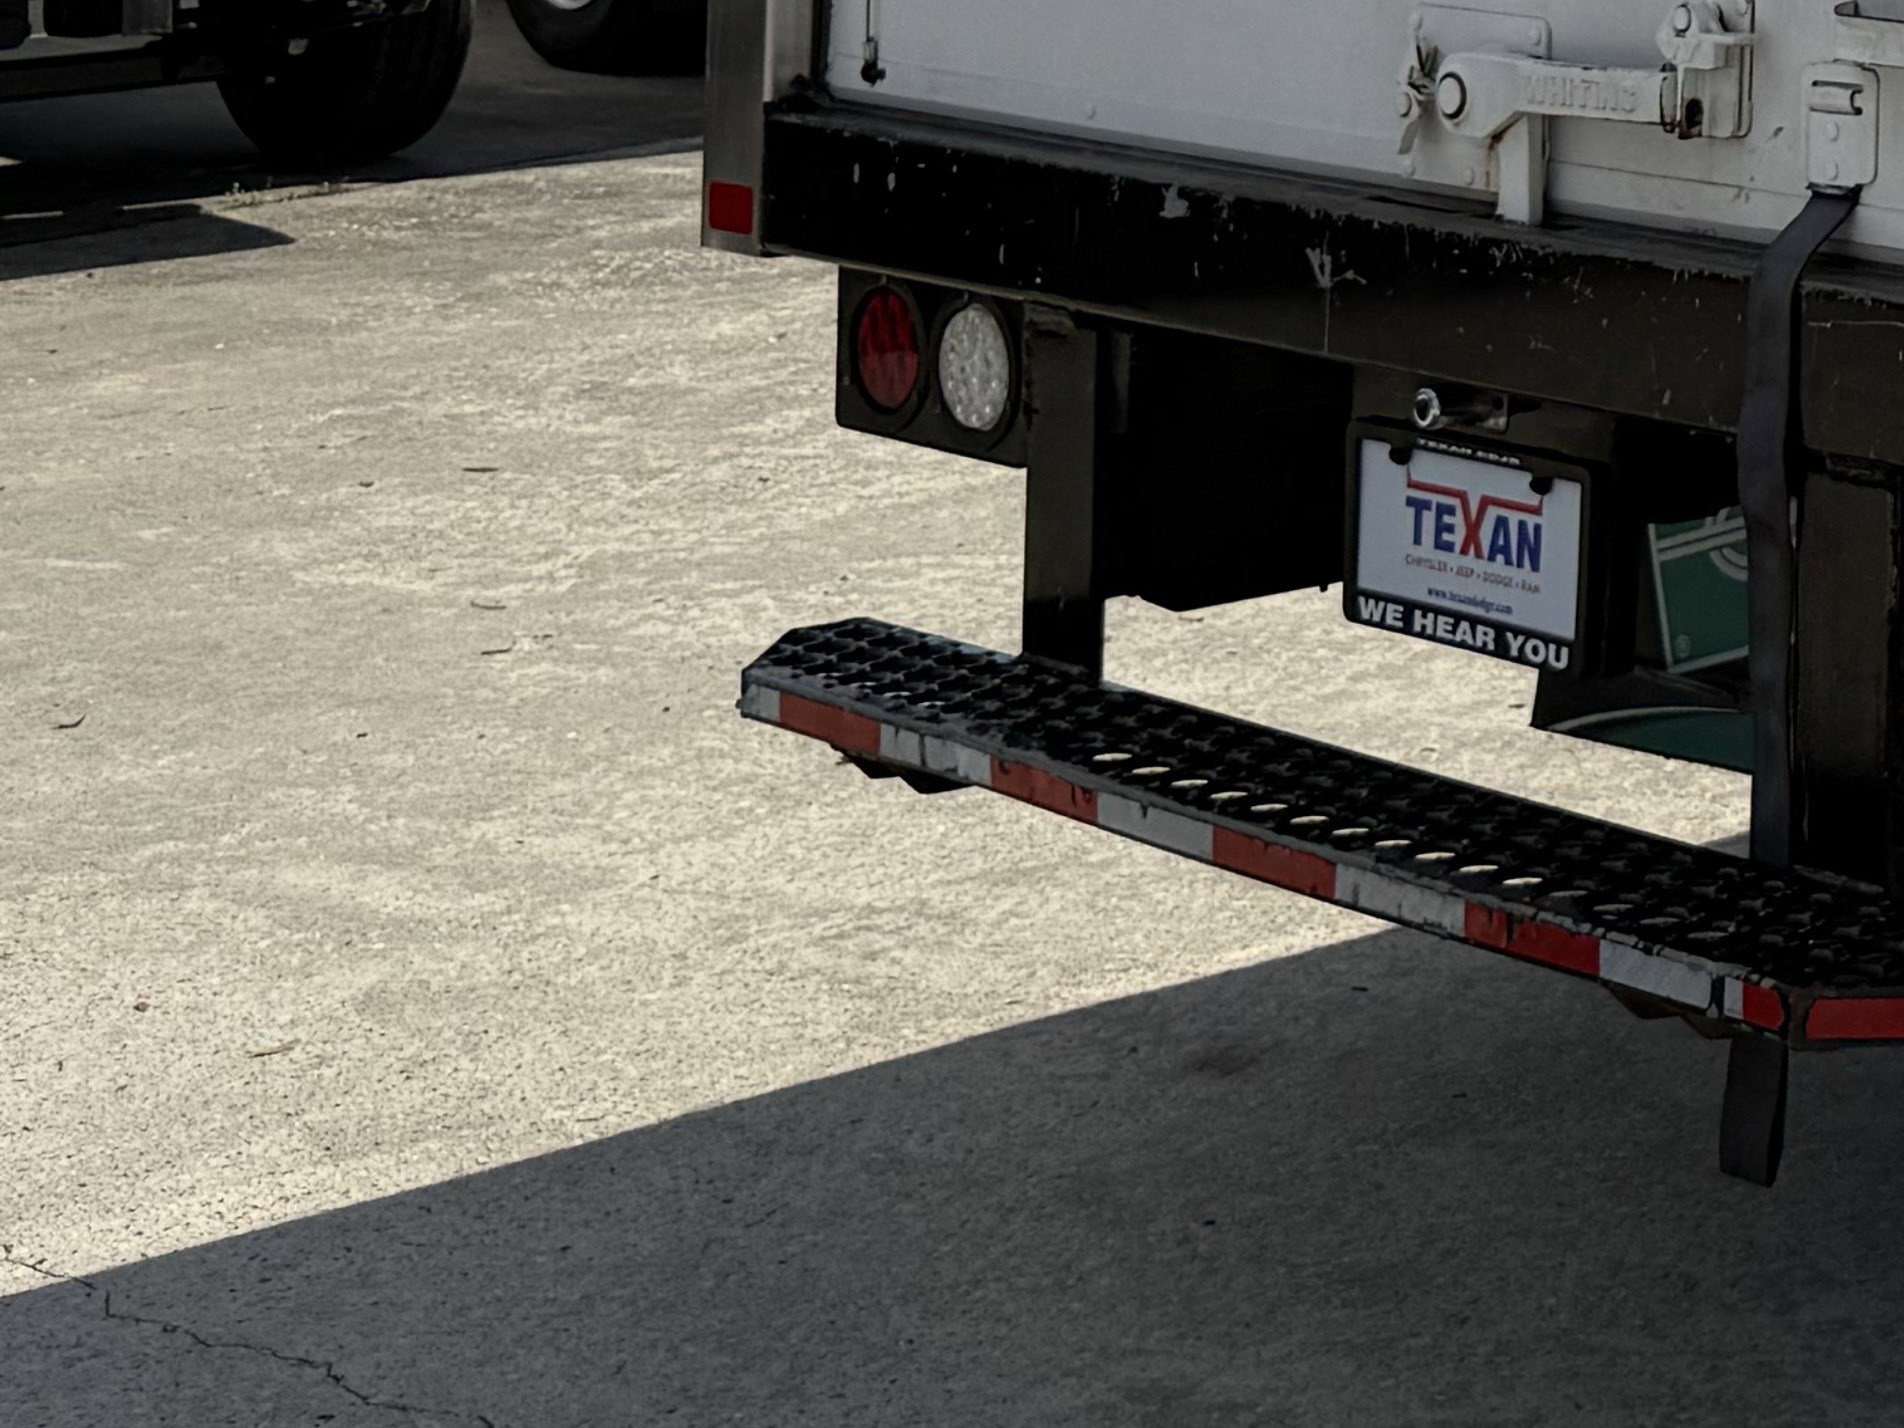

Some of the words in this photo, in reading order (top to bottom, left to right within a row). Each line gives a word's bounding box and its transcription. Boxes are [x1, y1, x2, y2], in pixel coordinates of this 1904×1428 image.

[1405, 478, 1543, 573] TEXAN
[1405, 554, 1448, 573] CHRYSLER
[1482, 571, 1513, 588] DODGE
[1521, 579, 1541, 594] RAM
[1358, 596, 1404, 628] WE
[1413, 609, 1496, 652] HEAR
[1504, 631, 1570, 670] YOU
